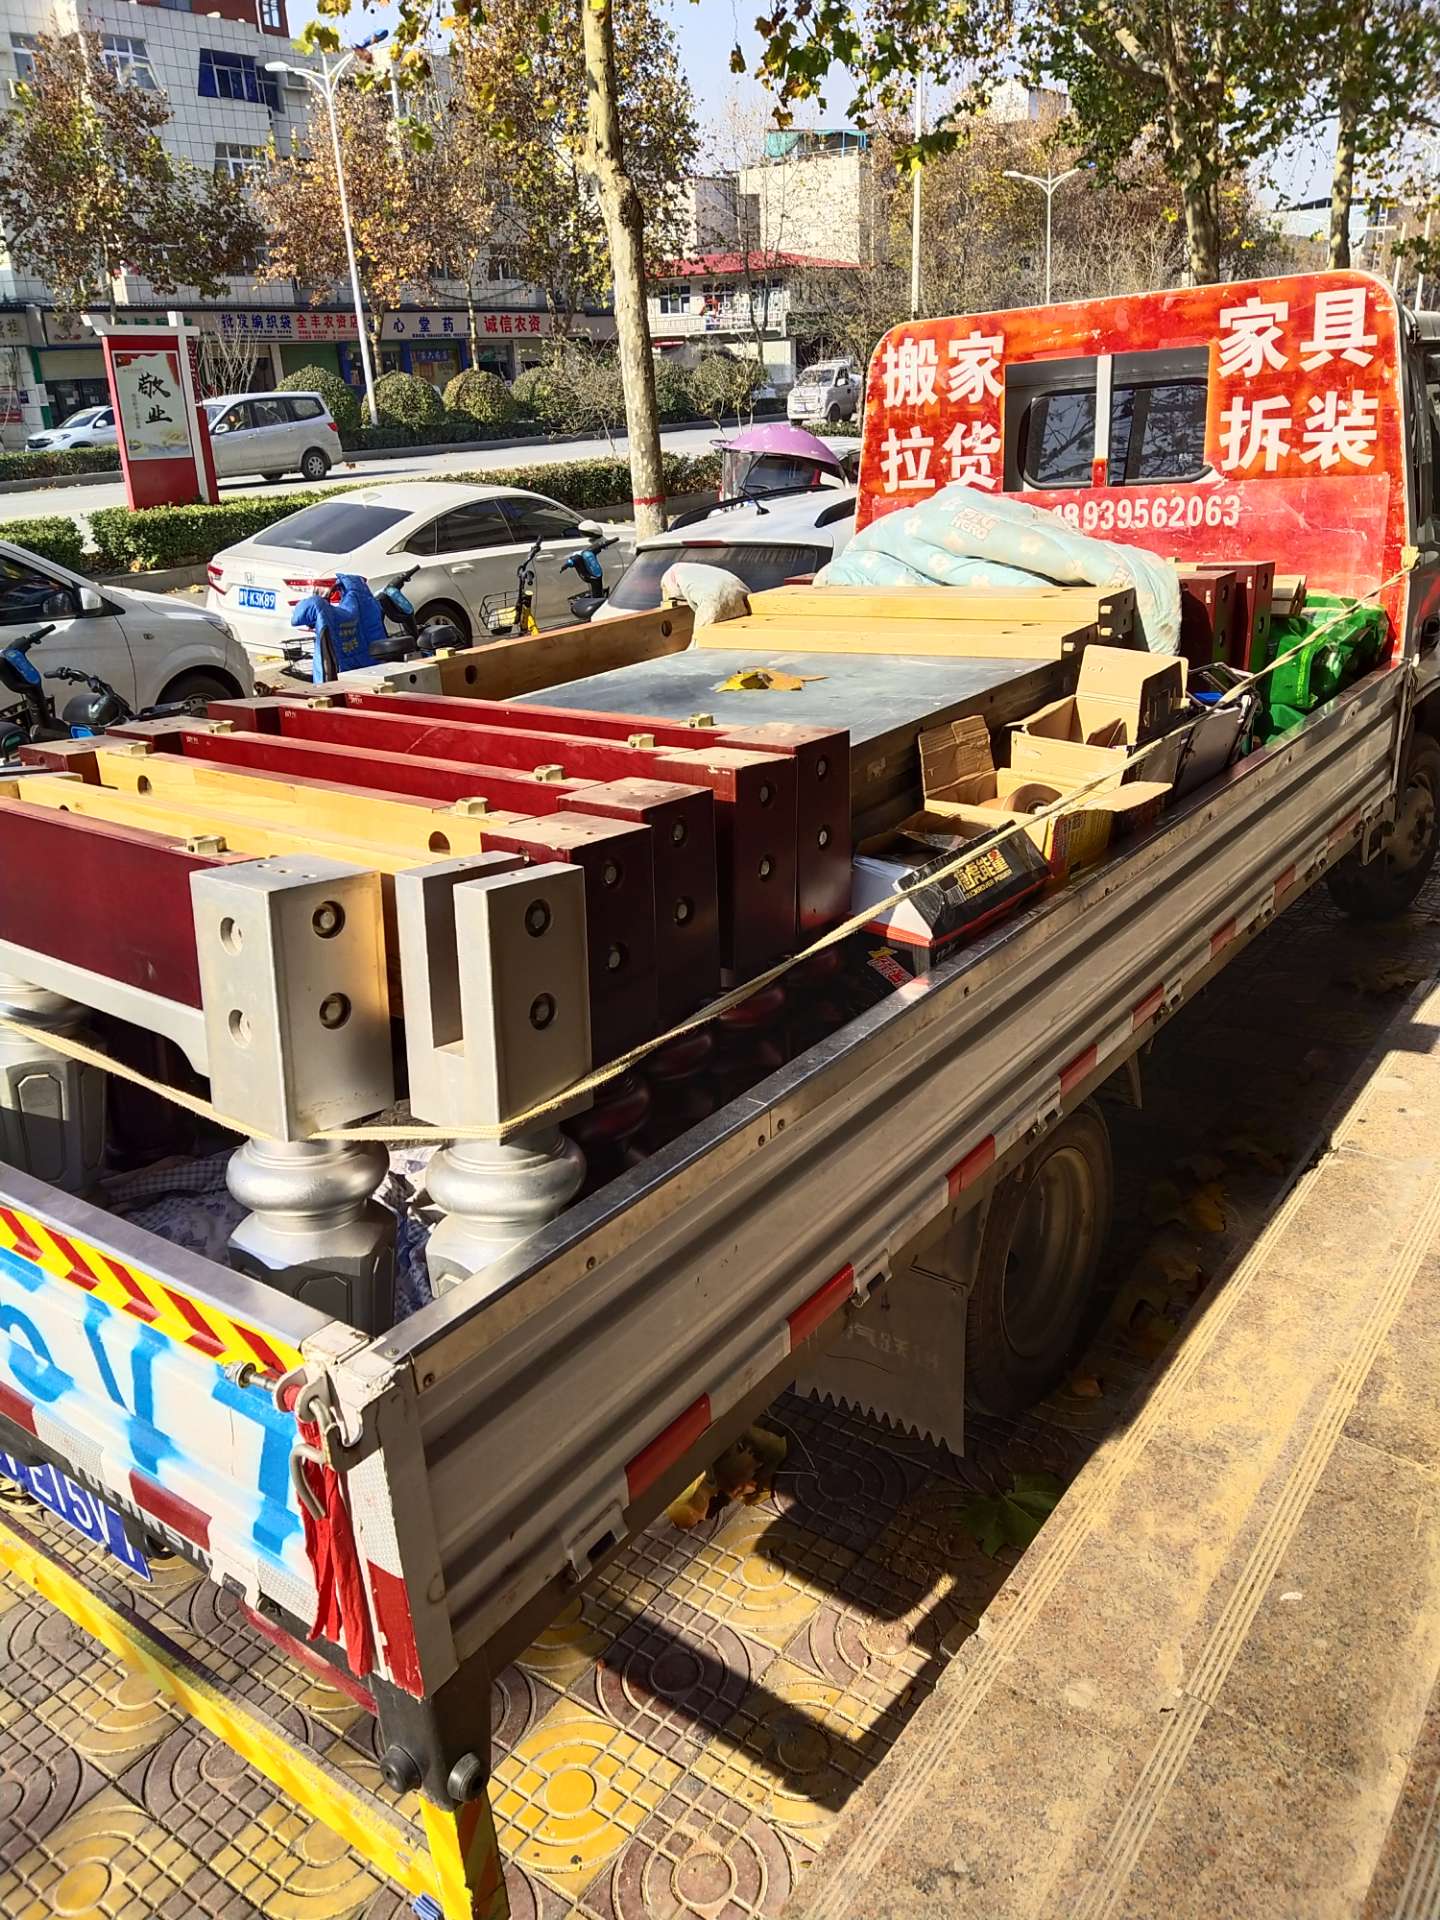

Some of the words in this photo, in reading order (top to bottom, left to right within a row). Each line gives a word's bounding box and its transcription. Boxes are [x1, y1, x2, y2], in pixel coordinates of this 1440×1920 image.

[221, 313, 292, 329] 批发编织袋
[483, 315, 541, 333] 诚信农资
[1217, 287, 1378, 378] 家具
[881, 330, 1005, 408] 搬家
[879, 421, 1001, 494] 拉货
[1219, 389, 1379, 472] 拆装
